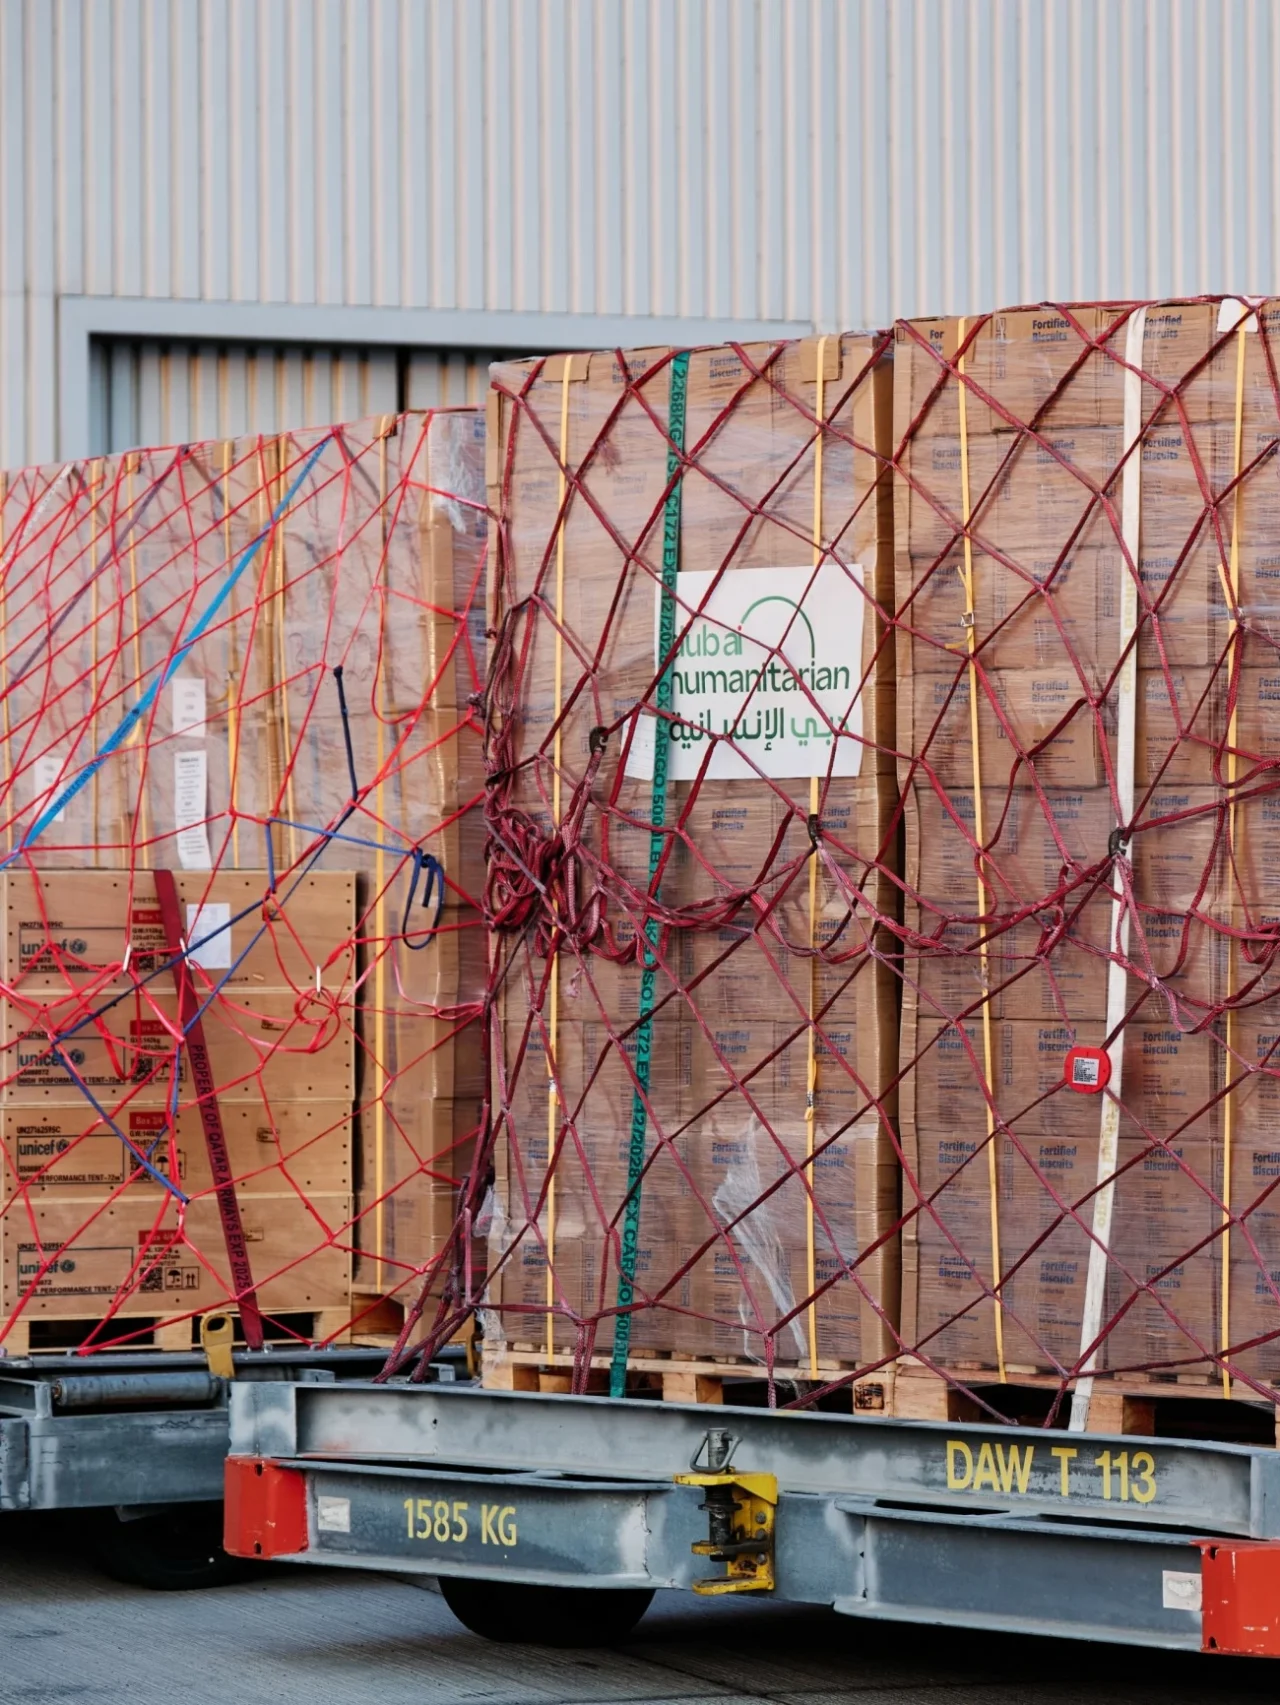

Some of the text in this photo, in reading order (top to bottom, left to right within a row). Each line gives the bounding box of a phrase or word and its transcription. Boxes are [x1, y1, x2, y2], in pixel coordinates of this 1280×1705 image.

[1032, 319, 1071, 331] Fortified
[1032, 332, 1068, 342] Biscuits
[669, 369, 687, 441] 2268KG
[1037, 440, 1075, 451] Ftified
[661, 547, 677, 587] EXP
[657, 681, 669, 709] CX
[942, 810, 975, 819] Bscuits
[650, 795, 665, 863] 500LB
[814, 920, 849, 930] Fortifid
[1145, 928, 1180, 938] Biscuits
[21, 938, 67, 955] unif
[815, 1032, 851, 1042] Ftified
[938, 1027, 975, 1038] Forted
[1143, 1031, 1182, 1042] Fortified
[815, 1046, 848, 1055] Biscits
[1143, 1044, 1178, 1055] Biscuits
[20, 1049, 60, 1067] unice
[191, 1044, 216, 1107] PROPERY
[204, 1113, 220, 1132] OF
[20, 1140, 55, 1155] unicef
[939, 1141, 977, 1152] Fortified
[1039, 1145, 1077, 1157] Fortified
[207, 1133, 228, 1172] QATAR
[1144, 1148, 1183, 1158] ortied
[939, 1154, 972, 1165] Biscuit
[1039, 1158, 1074, 1169] Biscuits
[1144, 1160, 1179, 1171] Biscuits
[217, 1176, 239, 1231] ARWAYS
[625, 1194, 640, 1222] CX
[228, 1234, 244, 1258] EXP
[816, 1258, 853, 1268] Fortifd
[939, 1256, 976, 1267] Fortifid
[1040, 1261, 1078, 1272] Fortified
[20, 1261, 59, 1274] unief
[1146, 1265, 1184, 1276] Forted
[816, 1270, 849, 1280] Biscts
[938, 1268, 972, 1280] Biscuits
[1040, 1274, 1075, 1284] Biscuits
[946, 1440, 1157, 1503] DAW T 113
[404, 1498, 517, 1546] 1585 KG
